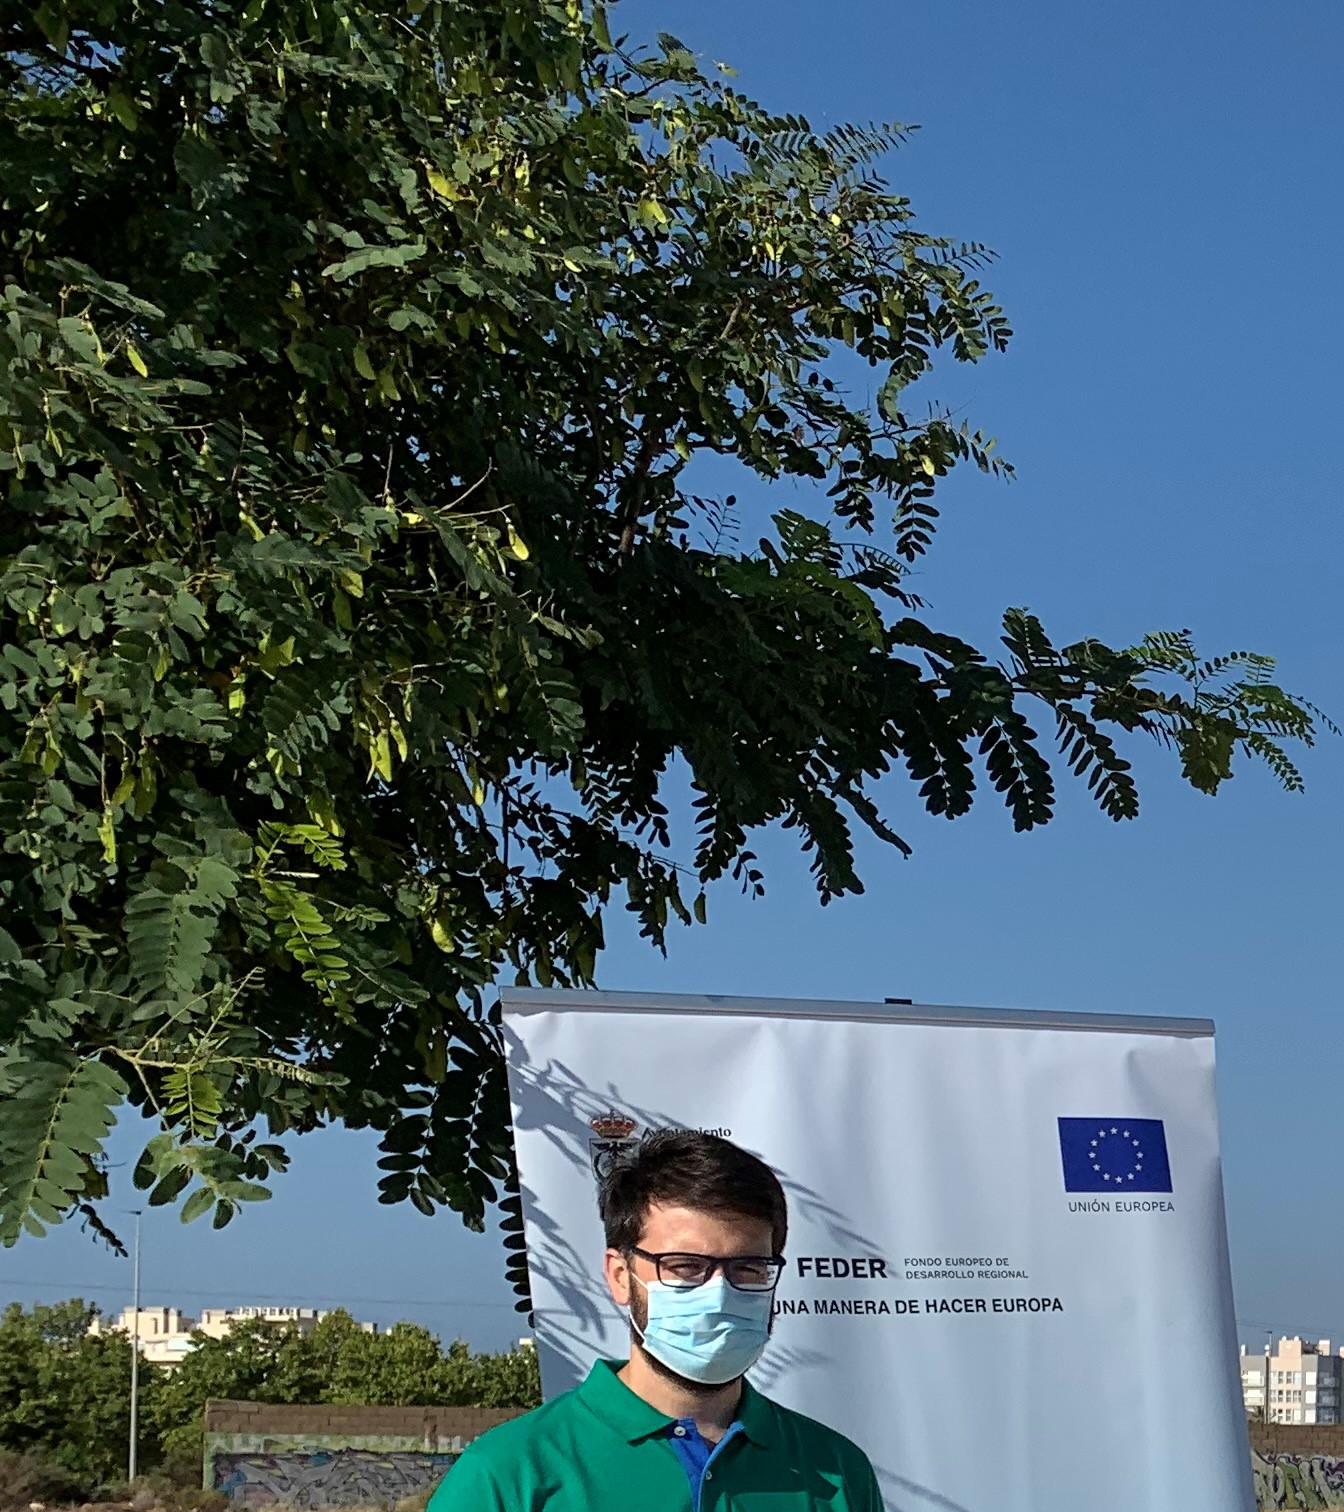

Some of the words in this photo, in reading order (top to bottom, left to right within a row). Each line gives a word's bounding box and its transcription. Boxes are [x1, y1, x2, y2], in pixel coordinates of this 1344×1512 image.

[1068, 1199, 1110, 1213] UNIÓN
[1115, 1201, 1175, 1212] EUROPEA
[797, 1257, 888, 1279] FEDER
[904, 1257, 941, 1267] FONDO
[945, 1257, 993, 1267] EUROPEO
[996, 1257, 1009, 1266] DE
[906, 1270, 974, 1279] DESARROLLO
[977, 1269, 1028, 1279] REGIONAL
[814, 1299, 890, 1315] MANERA
[895, 1299, 920, 1314] DE
[926, 1299, 987, 1314] HACER
[992, 1297, 1064, 1313] EUROPA
